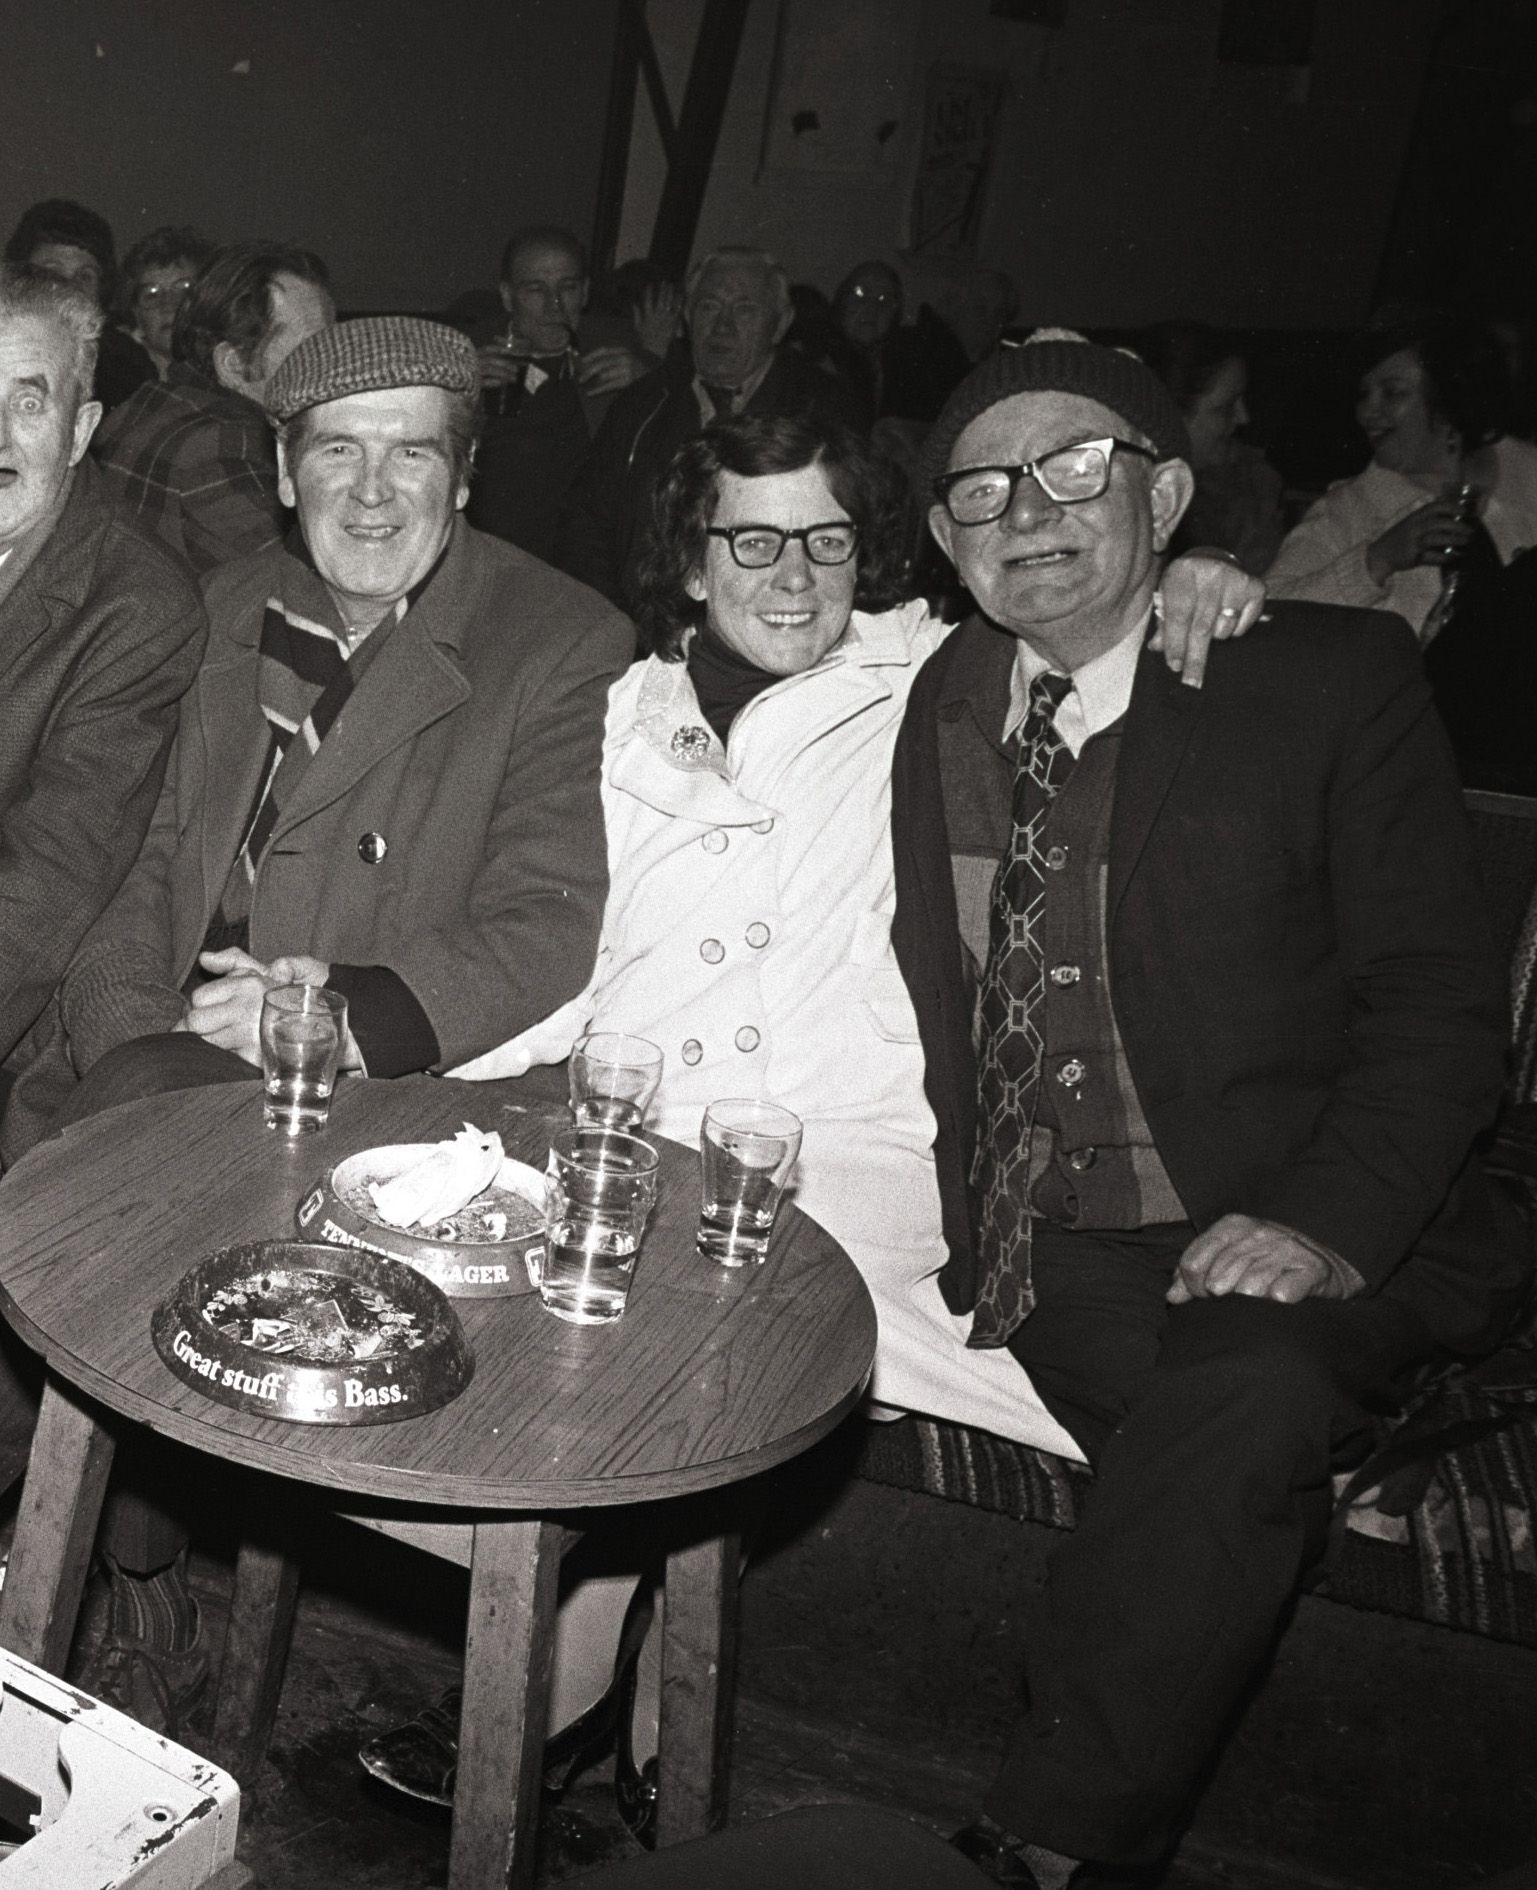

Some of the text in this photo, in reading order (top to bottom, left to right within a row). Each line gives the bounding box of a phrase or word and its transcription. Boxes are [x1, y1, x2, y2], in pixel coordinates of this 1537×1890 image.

[173, 1330, 222, 1381] Great
[221, 1369, 285, 1401] stuff
[344, 1378, 408, 1409] Bass.
